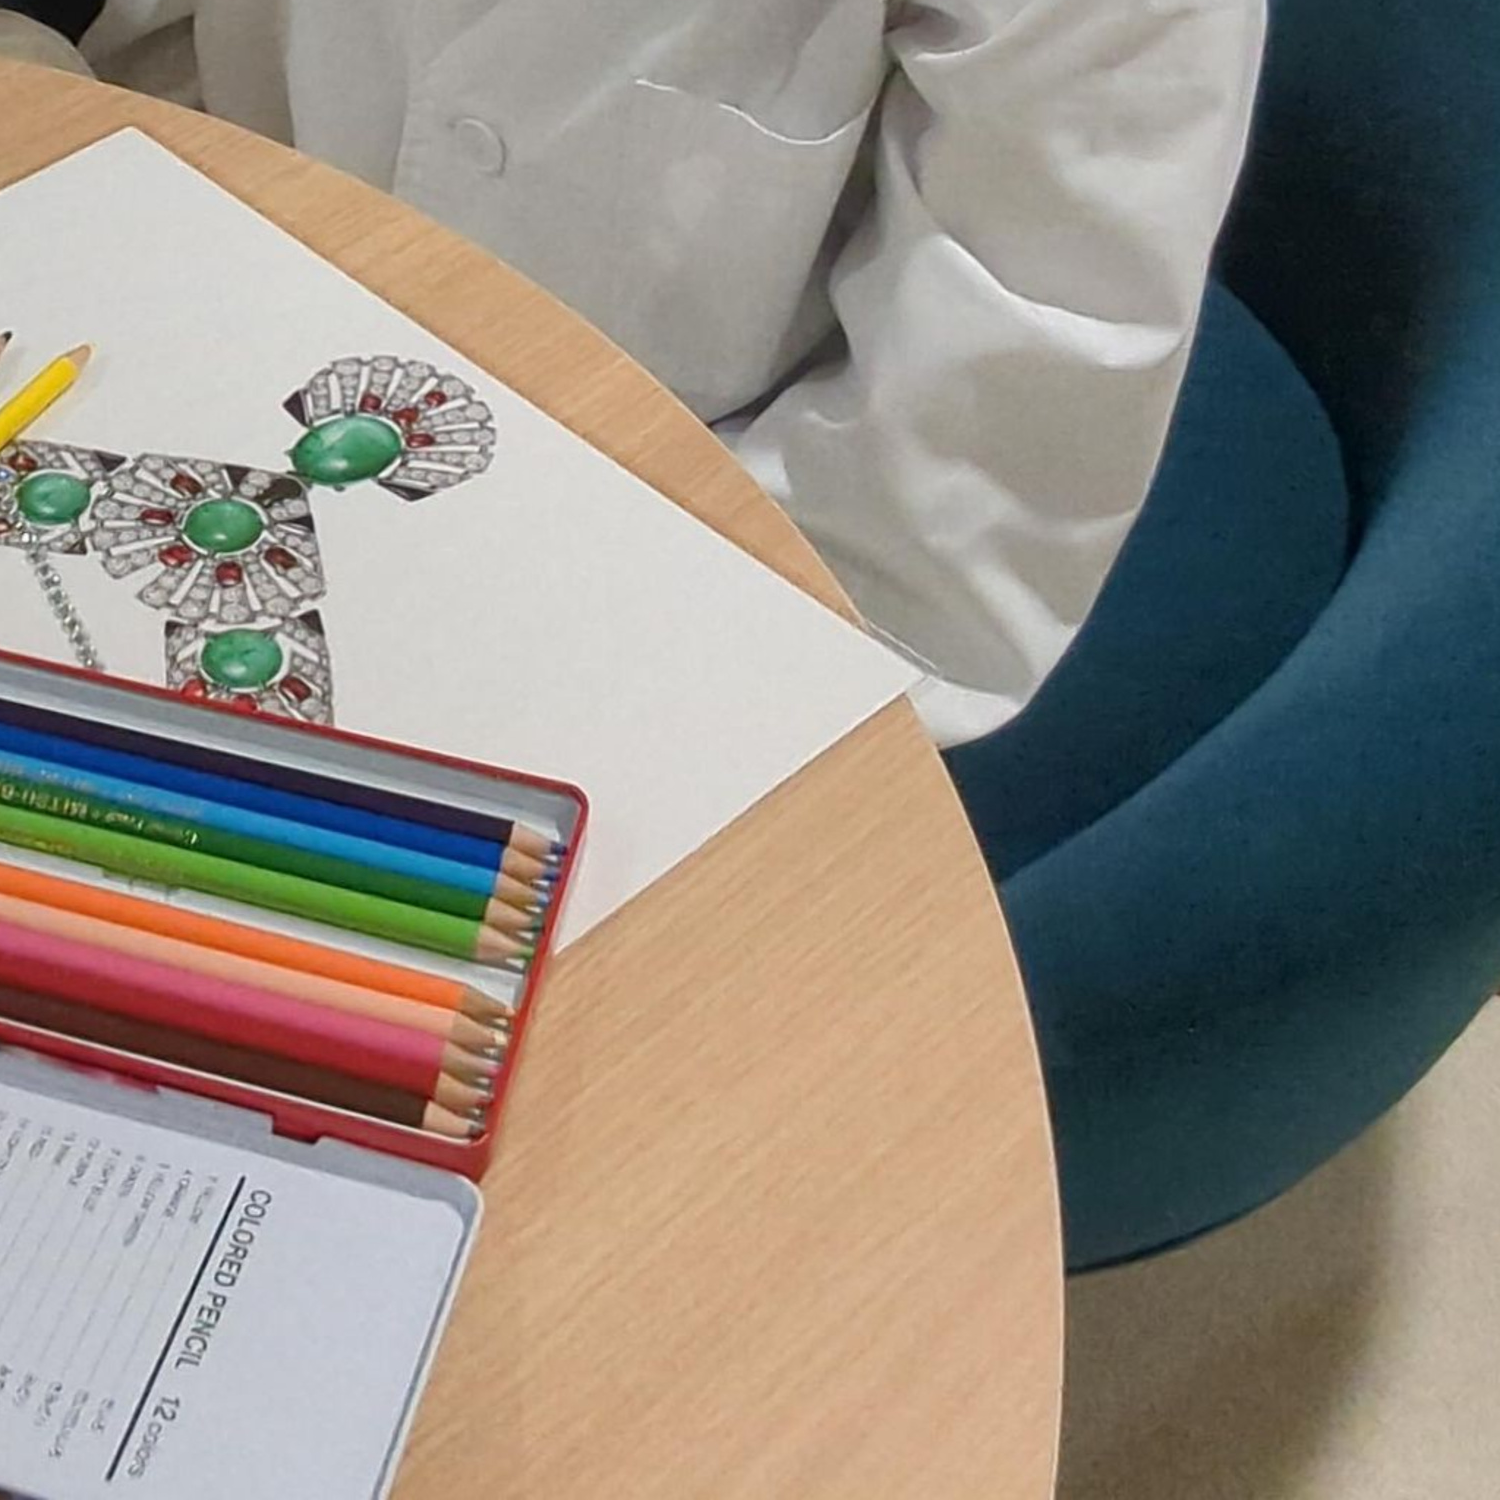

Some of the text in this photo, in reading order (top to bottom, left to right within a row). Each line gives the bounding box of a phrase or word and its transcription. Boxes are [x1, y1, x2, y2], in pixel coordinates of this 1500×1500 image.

[213, 1188, 272, 1288] COLORED
[174, 1290, 228, 1370] PENCIL
[153, 1395, 181, 1423] 12
